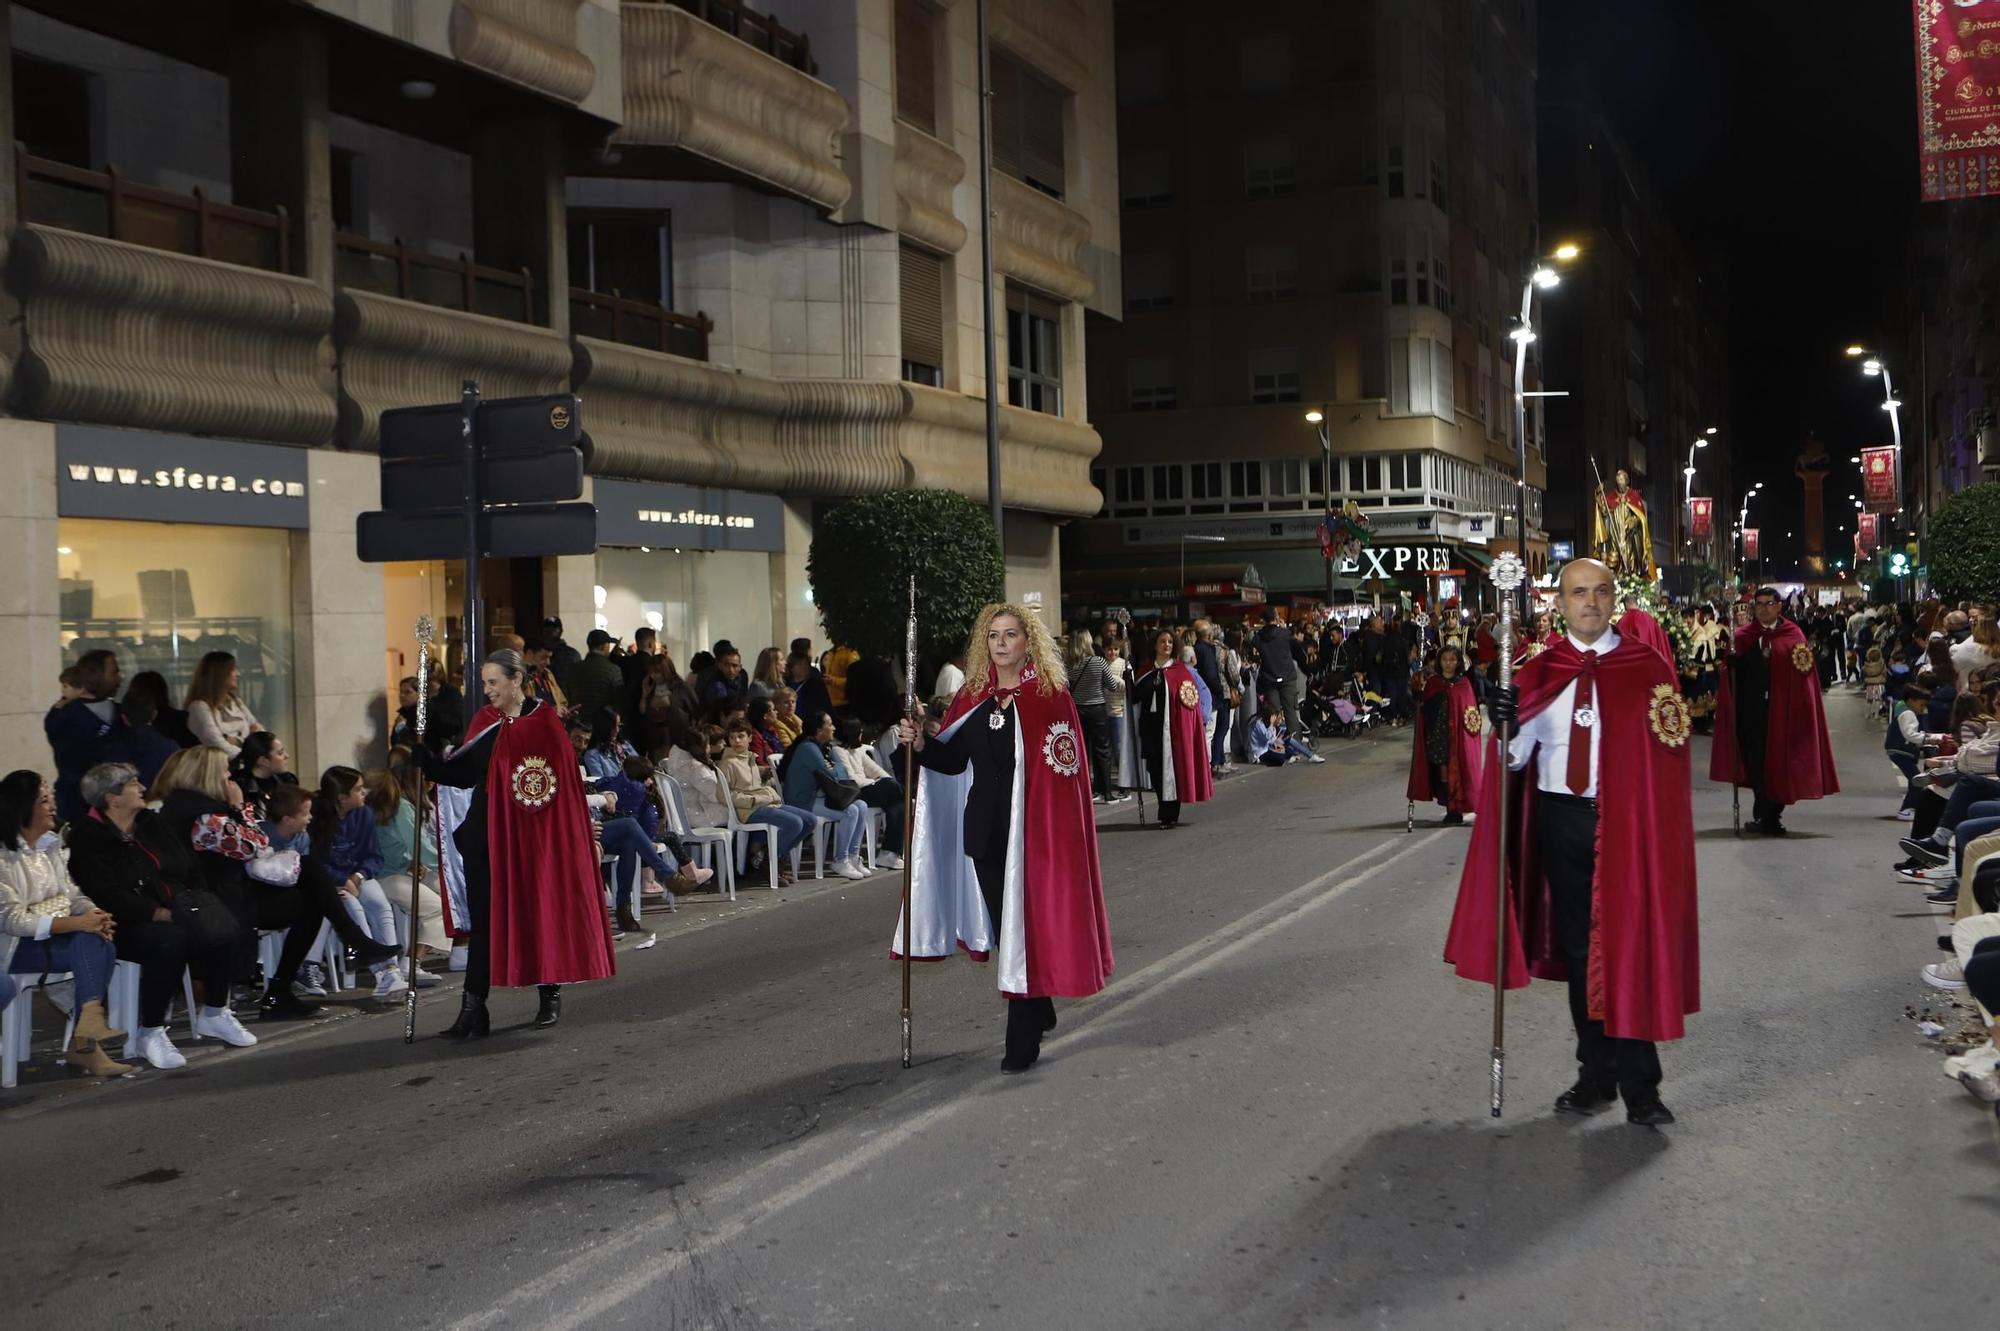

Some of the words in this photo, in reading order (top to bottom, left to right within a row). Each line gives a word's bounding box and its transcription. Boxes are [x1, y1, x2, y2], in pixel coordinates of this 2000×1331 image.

[1945, 106, 1978, 116] CIUDAD
[68, 464, 304, 497] www.sfera.com
[638, 509, 754, 528] www.sfera.com
